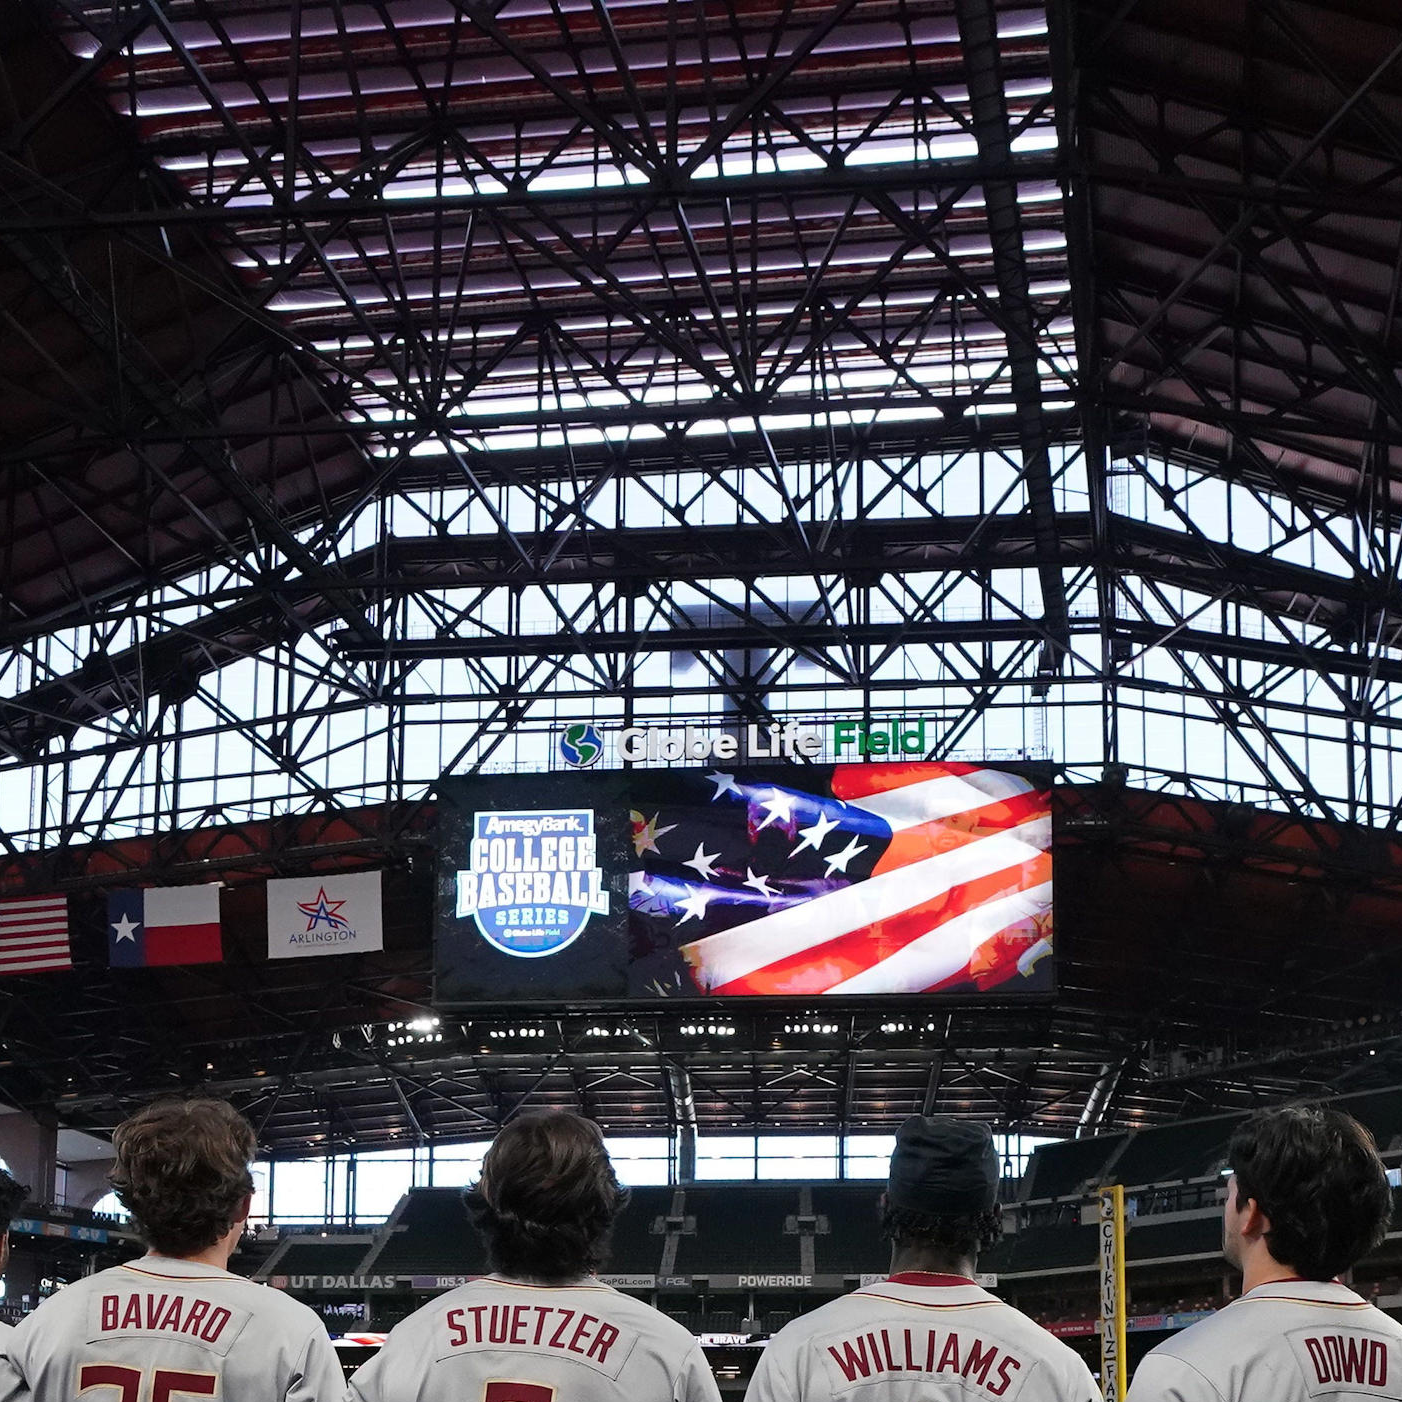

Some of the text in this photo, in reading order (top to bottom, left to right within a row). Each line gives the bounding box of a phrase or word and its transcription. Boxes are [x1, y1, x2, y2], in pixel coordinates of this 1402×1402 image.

[617, 717, 927, 762] Globe Life Field
[472, 836, 596, 873] COLLEGE
[459, 871, 607, 913] BASEBALL
[495, 908, 570, 926] SERIES
[289, 930, 357, 945] ARLINGTON
[291, 1275, 318, 1289] UT
[322, 1275, 398, 1289] DALLAS
[436, 1276, 466, 1288] 105.3
[738, 1275, 813, 1287] POWERADE
[1102, 1223, 1115, 1315] CHIKIN
[101, 1293, 232, 1344] BAVARO
[447, 1304, 620, 1364] STUETZER
[712, 1334, 747, 1345] BRAVE
[827, 1329, 1022, 1397] WILLIAMS
[1305, 1335, 1388, 1387] DOWD
